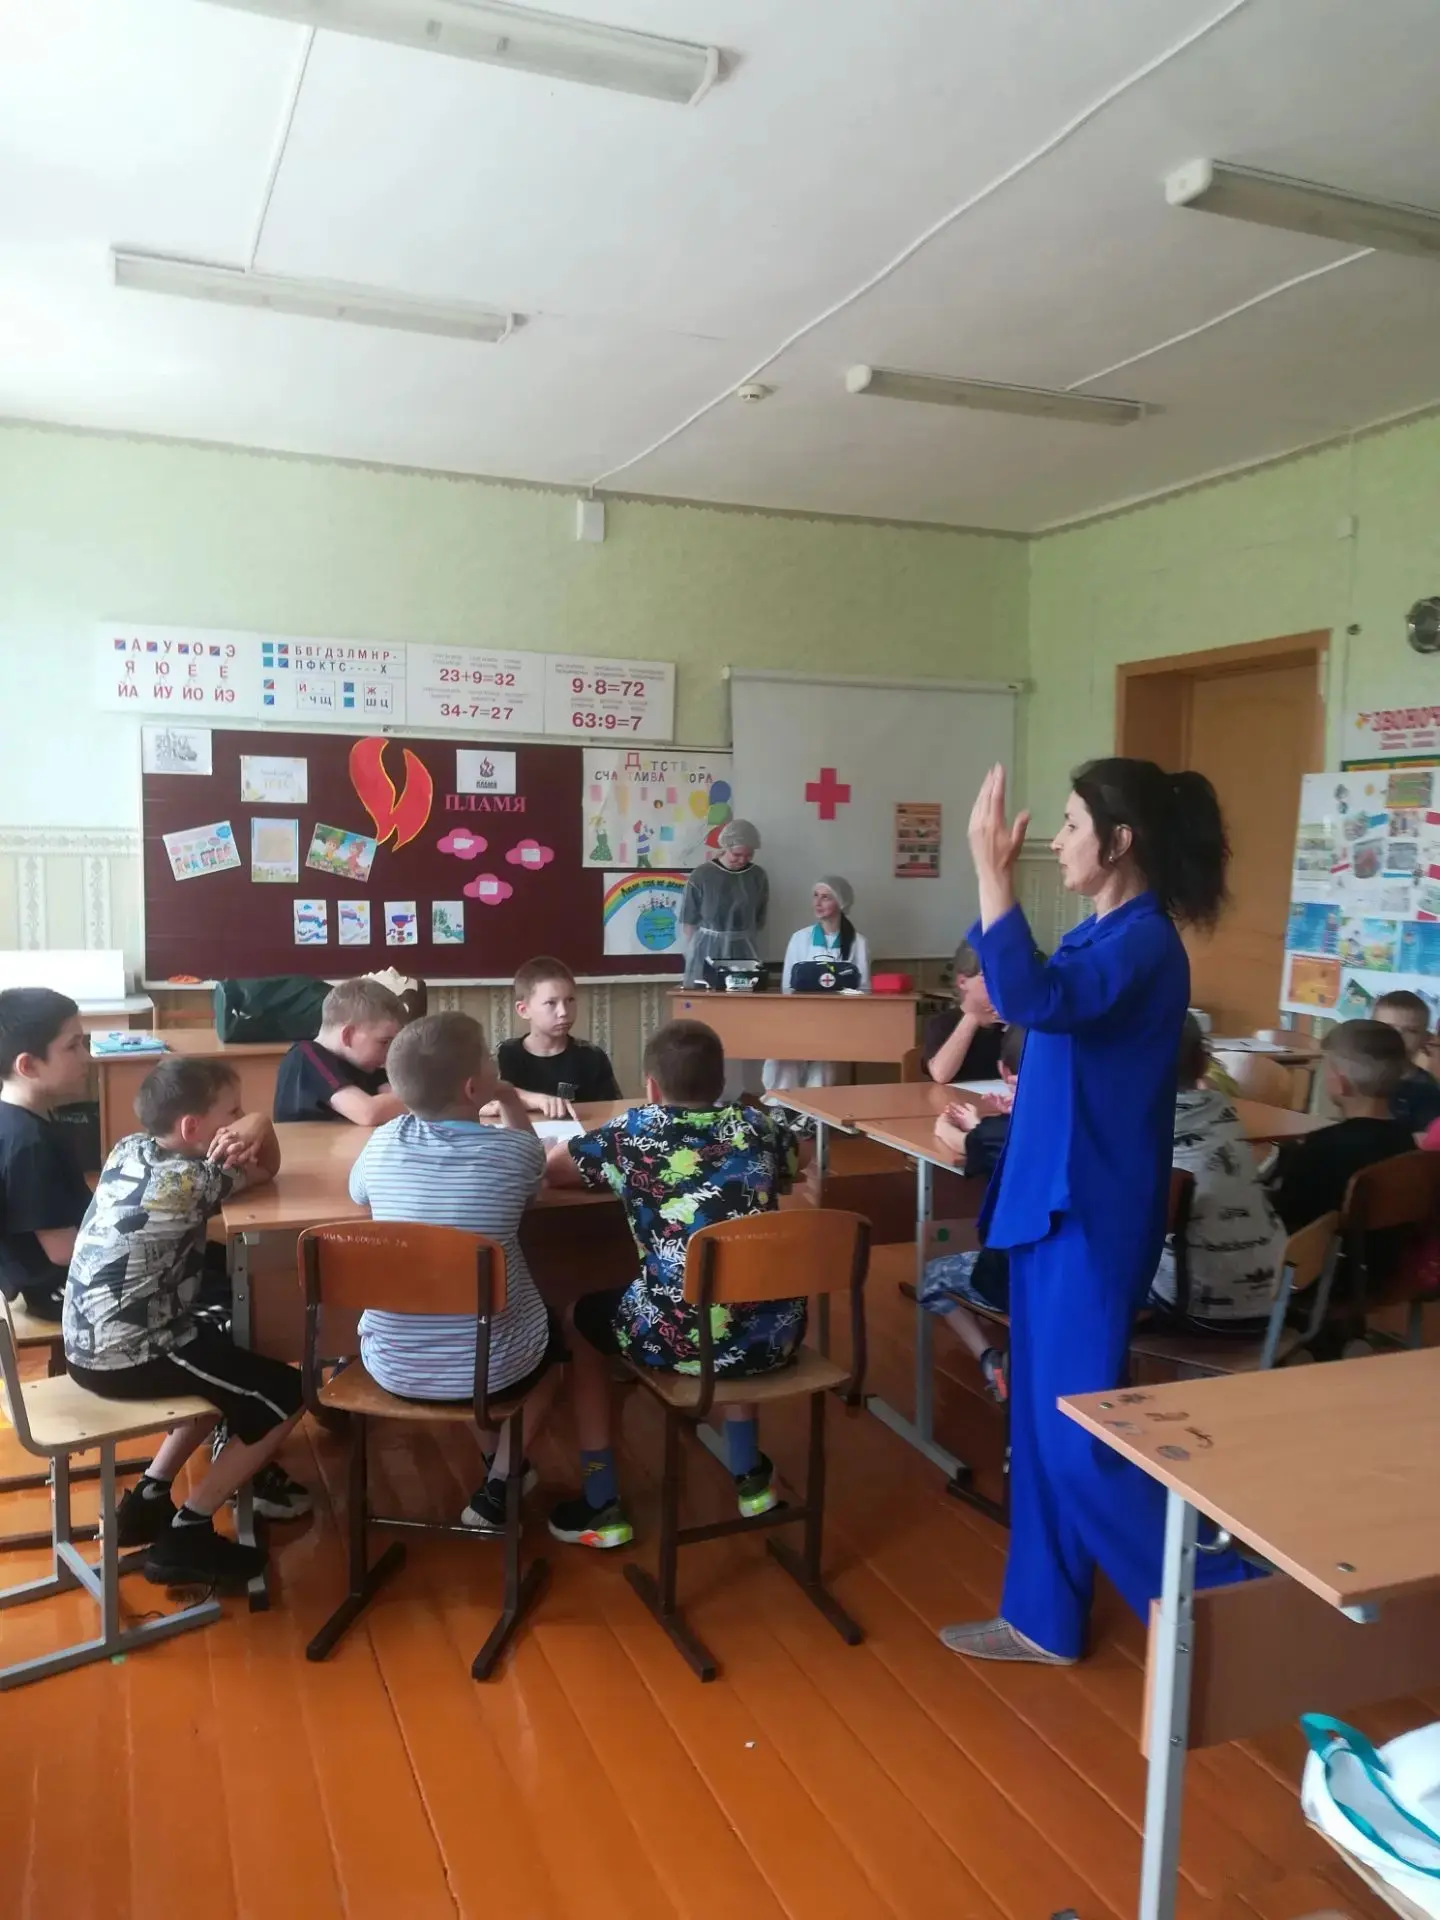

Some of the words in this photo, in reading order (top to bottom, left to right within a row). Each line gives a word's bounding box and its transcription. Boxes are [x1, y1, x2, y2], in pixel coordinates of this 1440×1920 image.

[225, 644, 235, 657] Э
[125, 660, 135, 673] Я
[155, 661, 170, 675] Ю
[439, 668, 515, 687] 23+9=32
[440, 703, 514, 721] 34-7=27
[572, 711, 643, 731] 63:9=7
[445, 794, 527, 813] ПЛАМЯ
